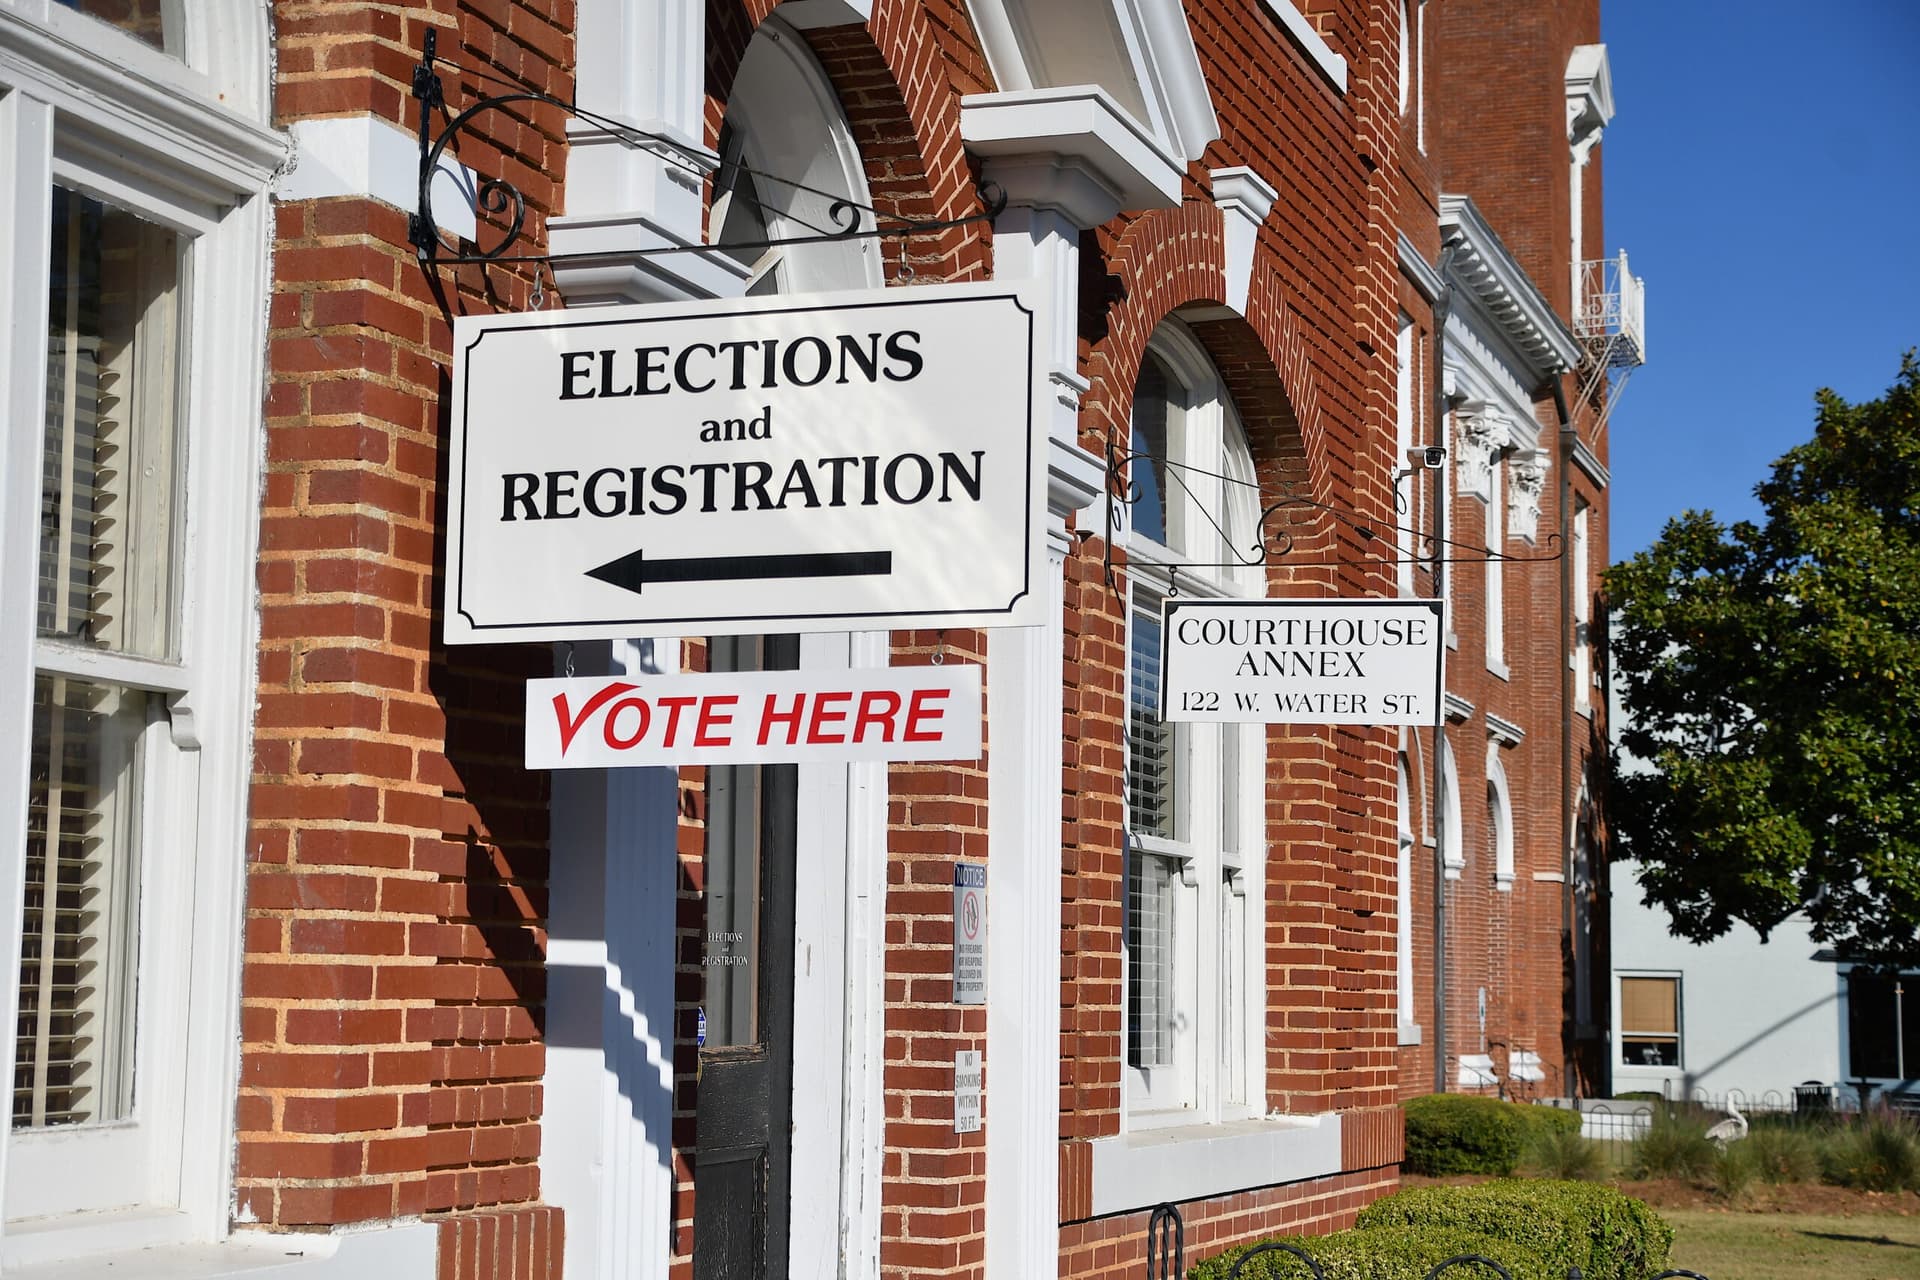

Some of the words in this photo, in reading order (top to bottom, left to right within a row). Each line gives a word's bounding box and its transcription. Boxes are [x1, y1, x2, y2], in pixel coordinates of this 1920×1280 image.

[559, 330, 924, 400] ELECTIONS
[699, 406, 772, 443] and
[500, 450, 986, 522] REGISTRATION
[1178, 618, 1428, 646] COURTHOUSE
[1235, 651, 1366, 677] ANNEX
[1182, 691, 1219, 712] 122
[1234, 692, 1260, 712] W.
[1275, 693, 1367, 714] WATER
[1382, 694, 1421, 715] ST.
[551, 682, 739, 759] VOTE
[756, 689, 950, 746] HERE
[957, 866, 984, 886] NOTICE
[708, 932, 743, 942] ELECTIONS
[702, 956, 748, 966] REGISTRATION
[965, 1053, 972, 1067] NO
[956, 1073, 980, 1088] SMOKING
[958, 1094, 978, 1109] WITHIN
[961, 1116, 967, 1130] 50
